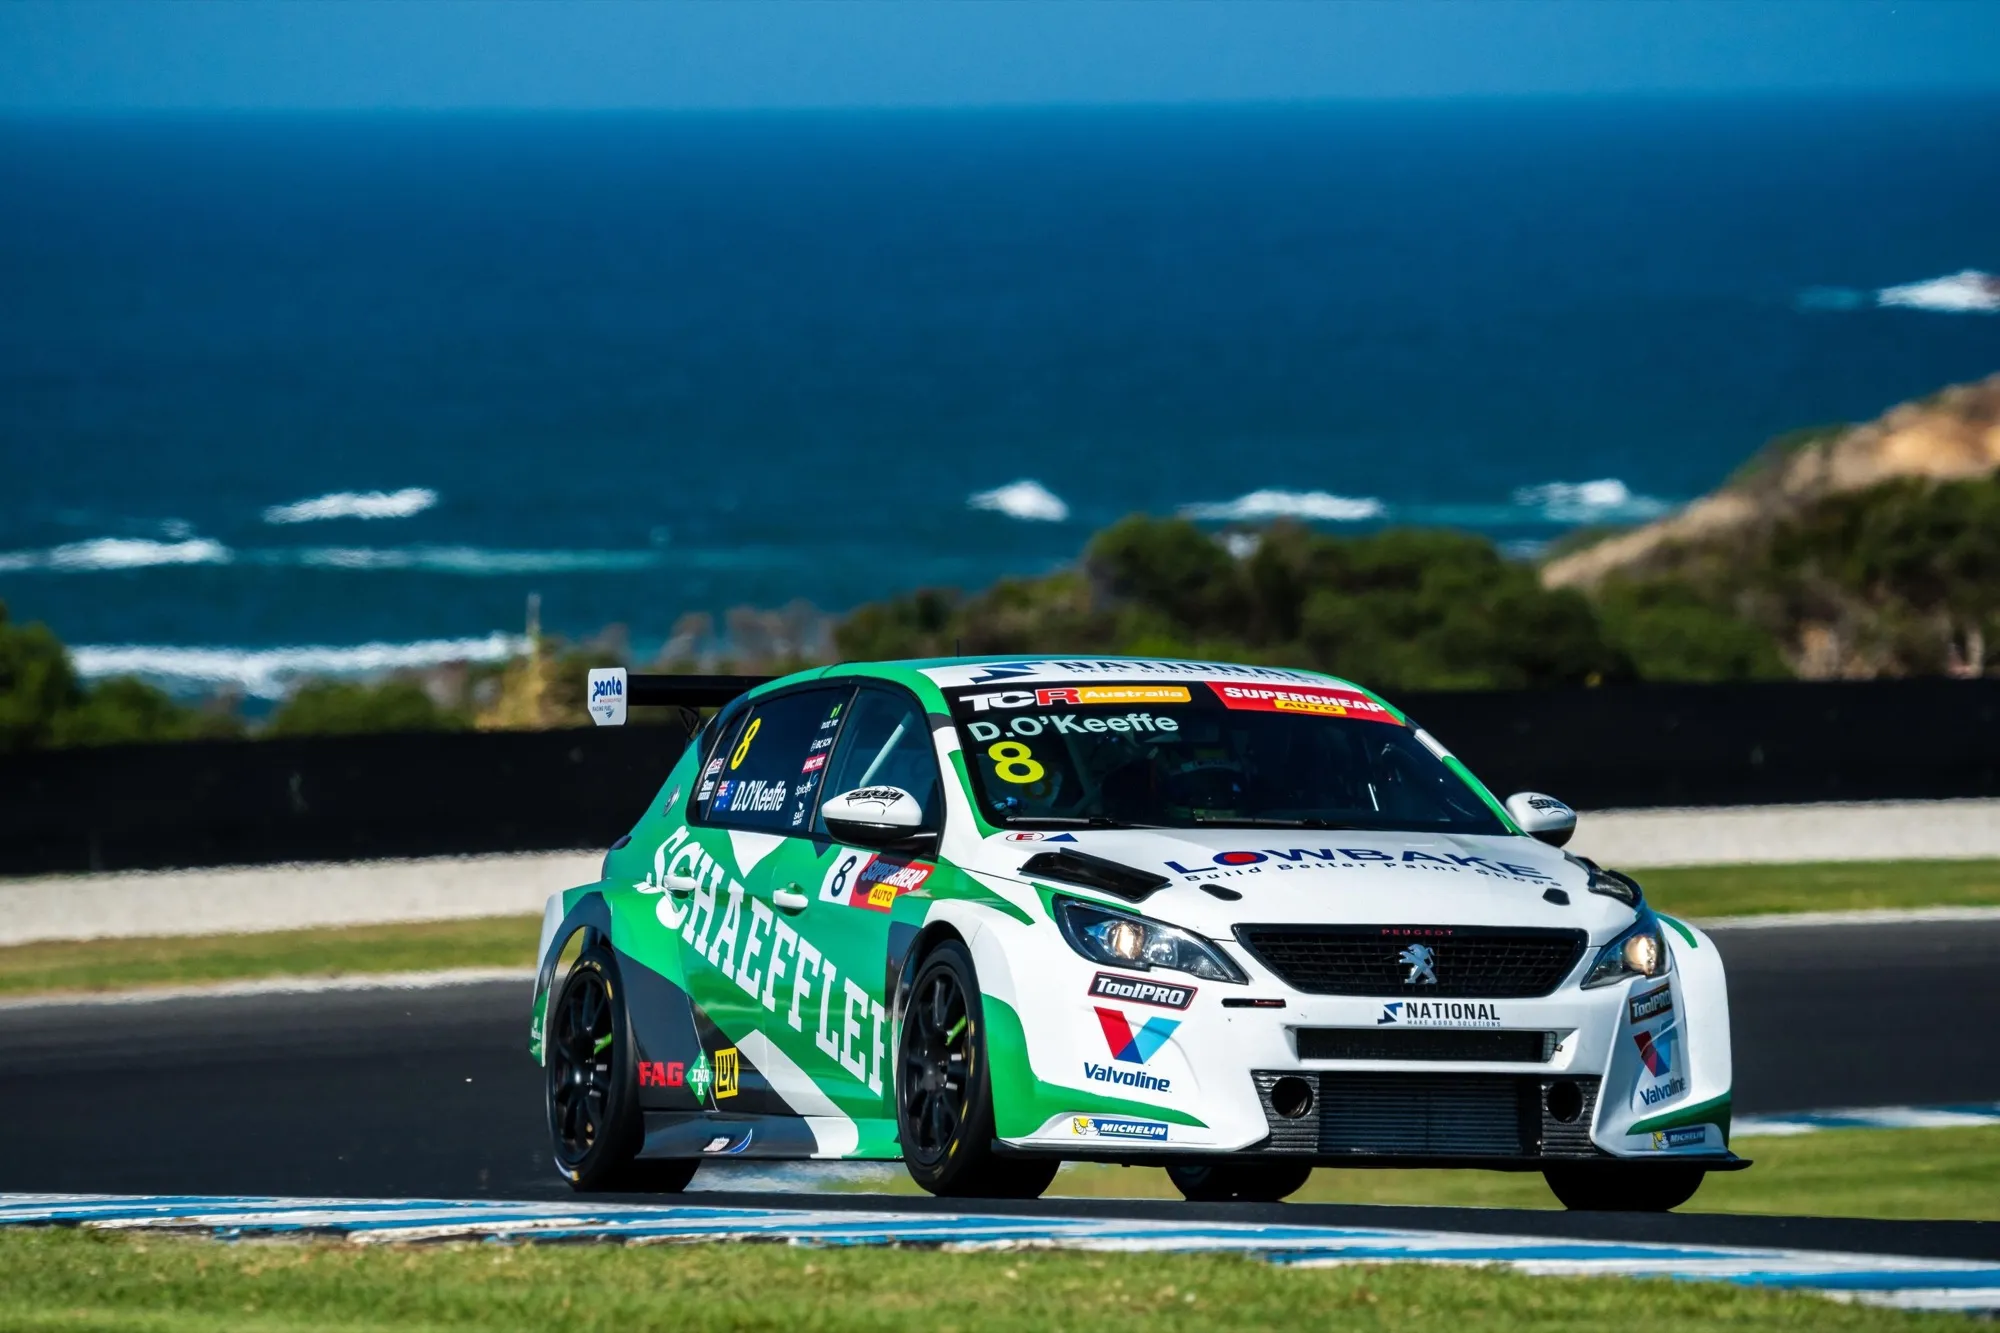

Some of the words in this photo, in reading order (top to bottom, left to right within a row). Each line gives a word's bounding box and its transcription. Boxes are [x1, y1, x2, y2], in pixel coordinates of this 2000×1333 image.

[959, 687, 1083, 711] TCR
[1085, 689, 1184, 700] Australia
[1224, 687, 1385, 713] SUPERCHEAP
[1283, 702, 1338, 712] AUTO
[967, 713, 1179, 742] D.O'Keeffe
[731, 718, 761, 770] 8
[988, 741, 1044, 784] 8
[730, 780, 787, 811] D.O'Keeffe
[831, 855, 857, 897] 8
[861, 860, 928, 890] SUPERCHEAP
[1163, 849, 1554, 879] LOWBAKE
[1184, 866, 1262, 882] Build
[1277, 862, 1368, 870] Better
[1383, 862, 1461, 872] Paint
[1474, 868, 1563, 887] Shops
[872, 889, 893, 902] AUTO
[1381, 928, 1453, 936] PEUGEOT
[1096, 978, 1186, 1005] ToolPRO
[1632, 989, 1671, 1018] ToolPRO
[1406, 1002, 1501, 1021] NATIONAL
[638, 1062, 684, 1087] FAG
[1084, 1062, 1170, 1092] Valvoline
[1640, 1077, 1686, 1106] Valvoline
[1101, 1123, 1166, 1136] MICHELIN
